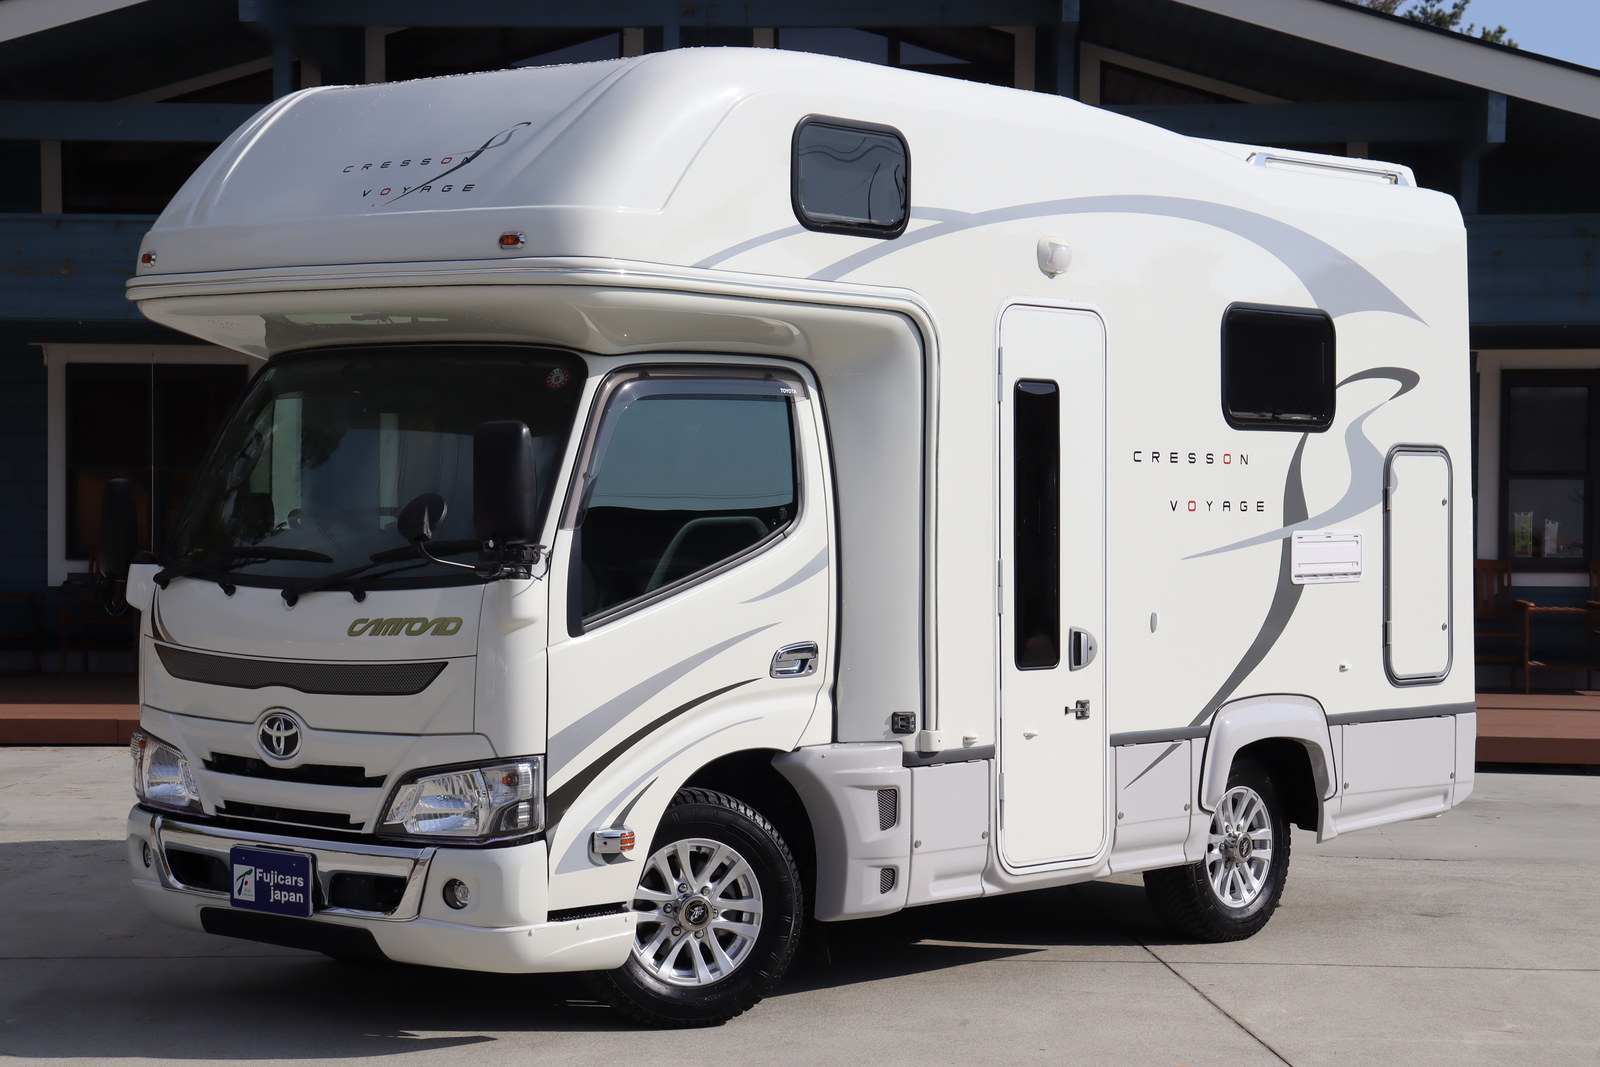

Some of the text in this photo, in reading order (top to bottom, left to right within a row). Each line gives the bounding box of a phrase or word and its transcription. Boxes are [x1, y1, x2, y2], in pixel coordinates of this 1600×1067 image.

[362, 183, 475, 198] VOYAGE
[1133, 450, 1249, 466] CRESSON
[1169, 500, 1265, 512] VOYAGE
[347, 616, 464, 637] CAMROAD
[256, 868, 305, 887] Fujicars
[269, 886, 304, 904] japan
